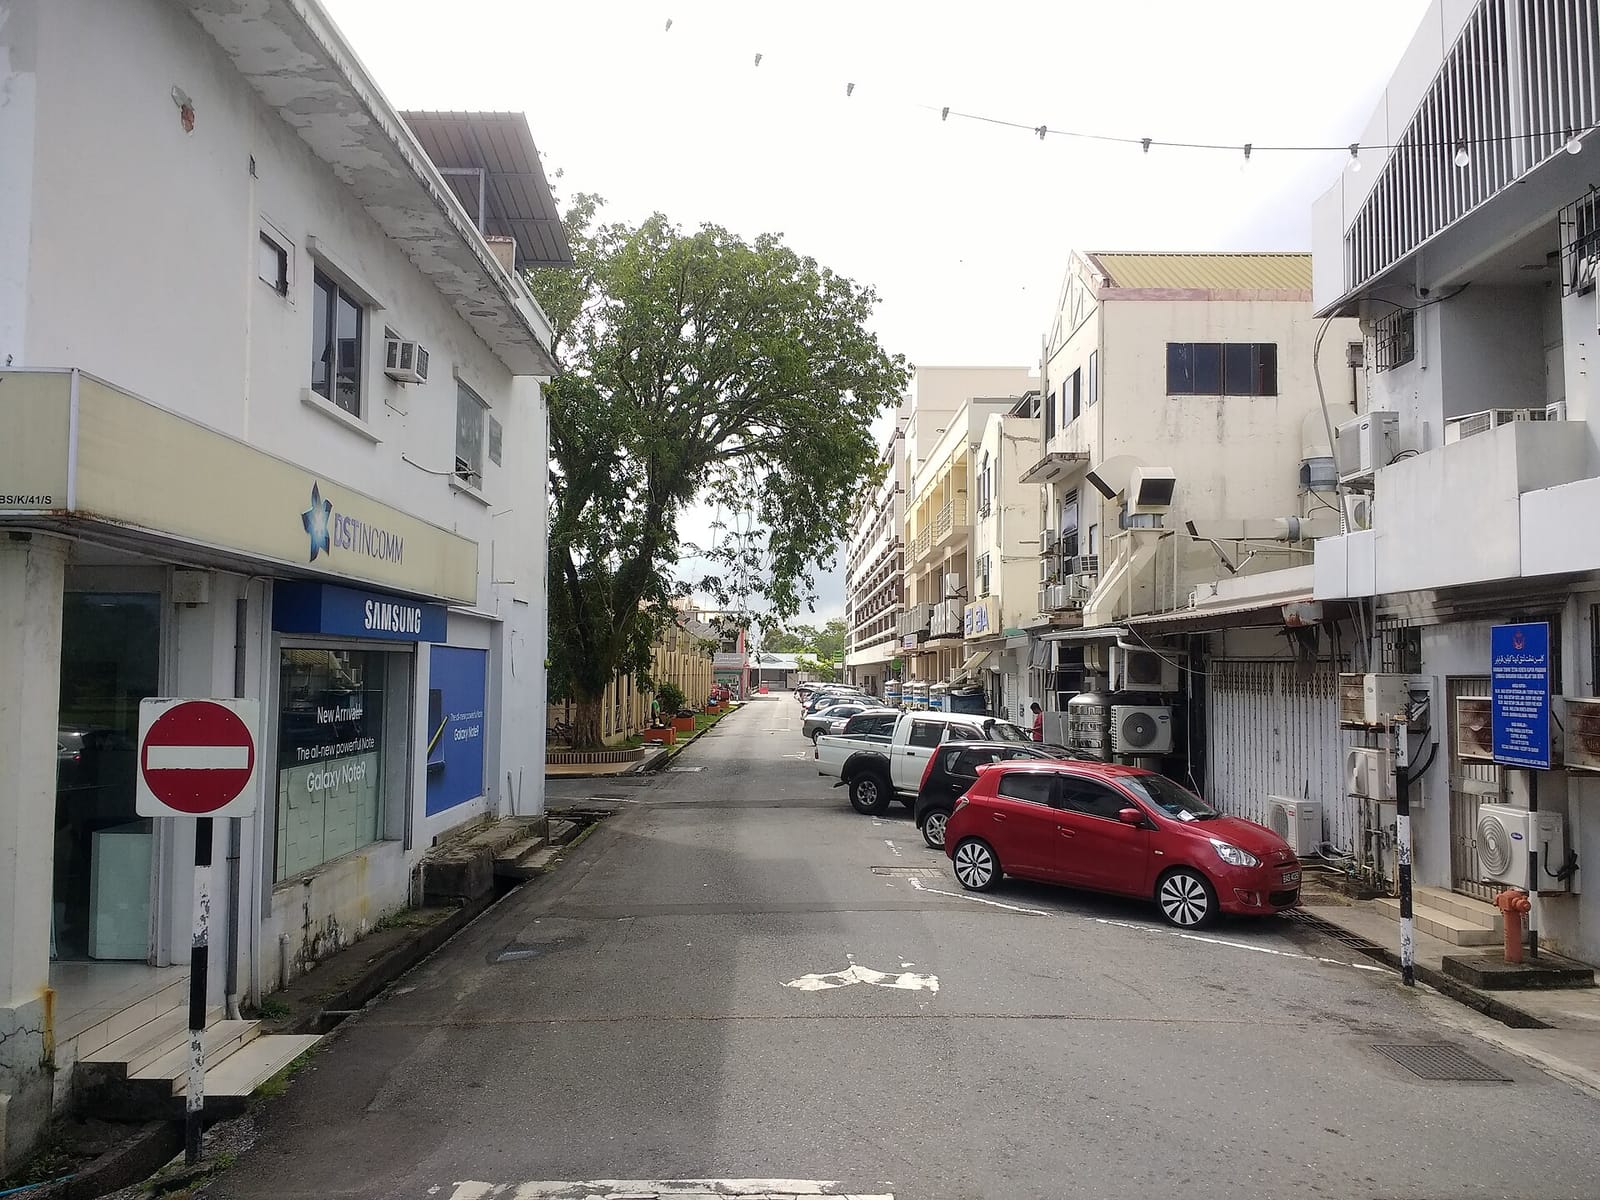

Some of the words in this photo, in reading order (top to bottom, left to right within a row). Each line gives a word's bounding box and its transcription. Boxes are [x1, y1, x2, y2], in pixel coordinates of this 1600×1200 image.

[364, 599, 422, 634] SAMSUNG
[316, 705, 335, 724] New
[453, 728, 469, 742] Galaxy
[296, 746, 311, 761] The
[310, 744, 336, 759] all-new
[335, 737, 363, 758] powerful
[361, 736, 375, 751] Note
[306, 768, 341, 792] Galaxy
[342, 761, 366, 784] Note9
